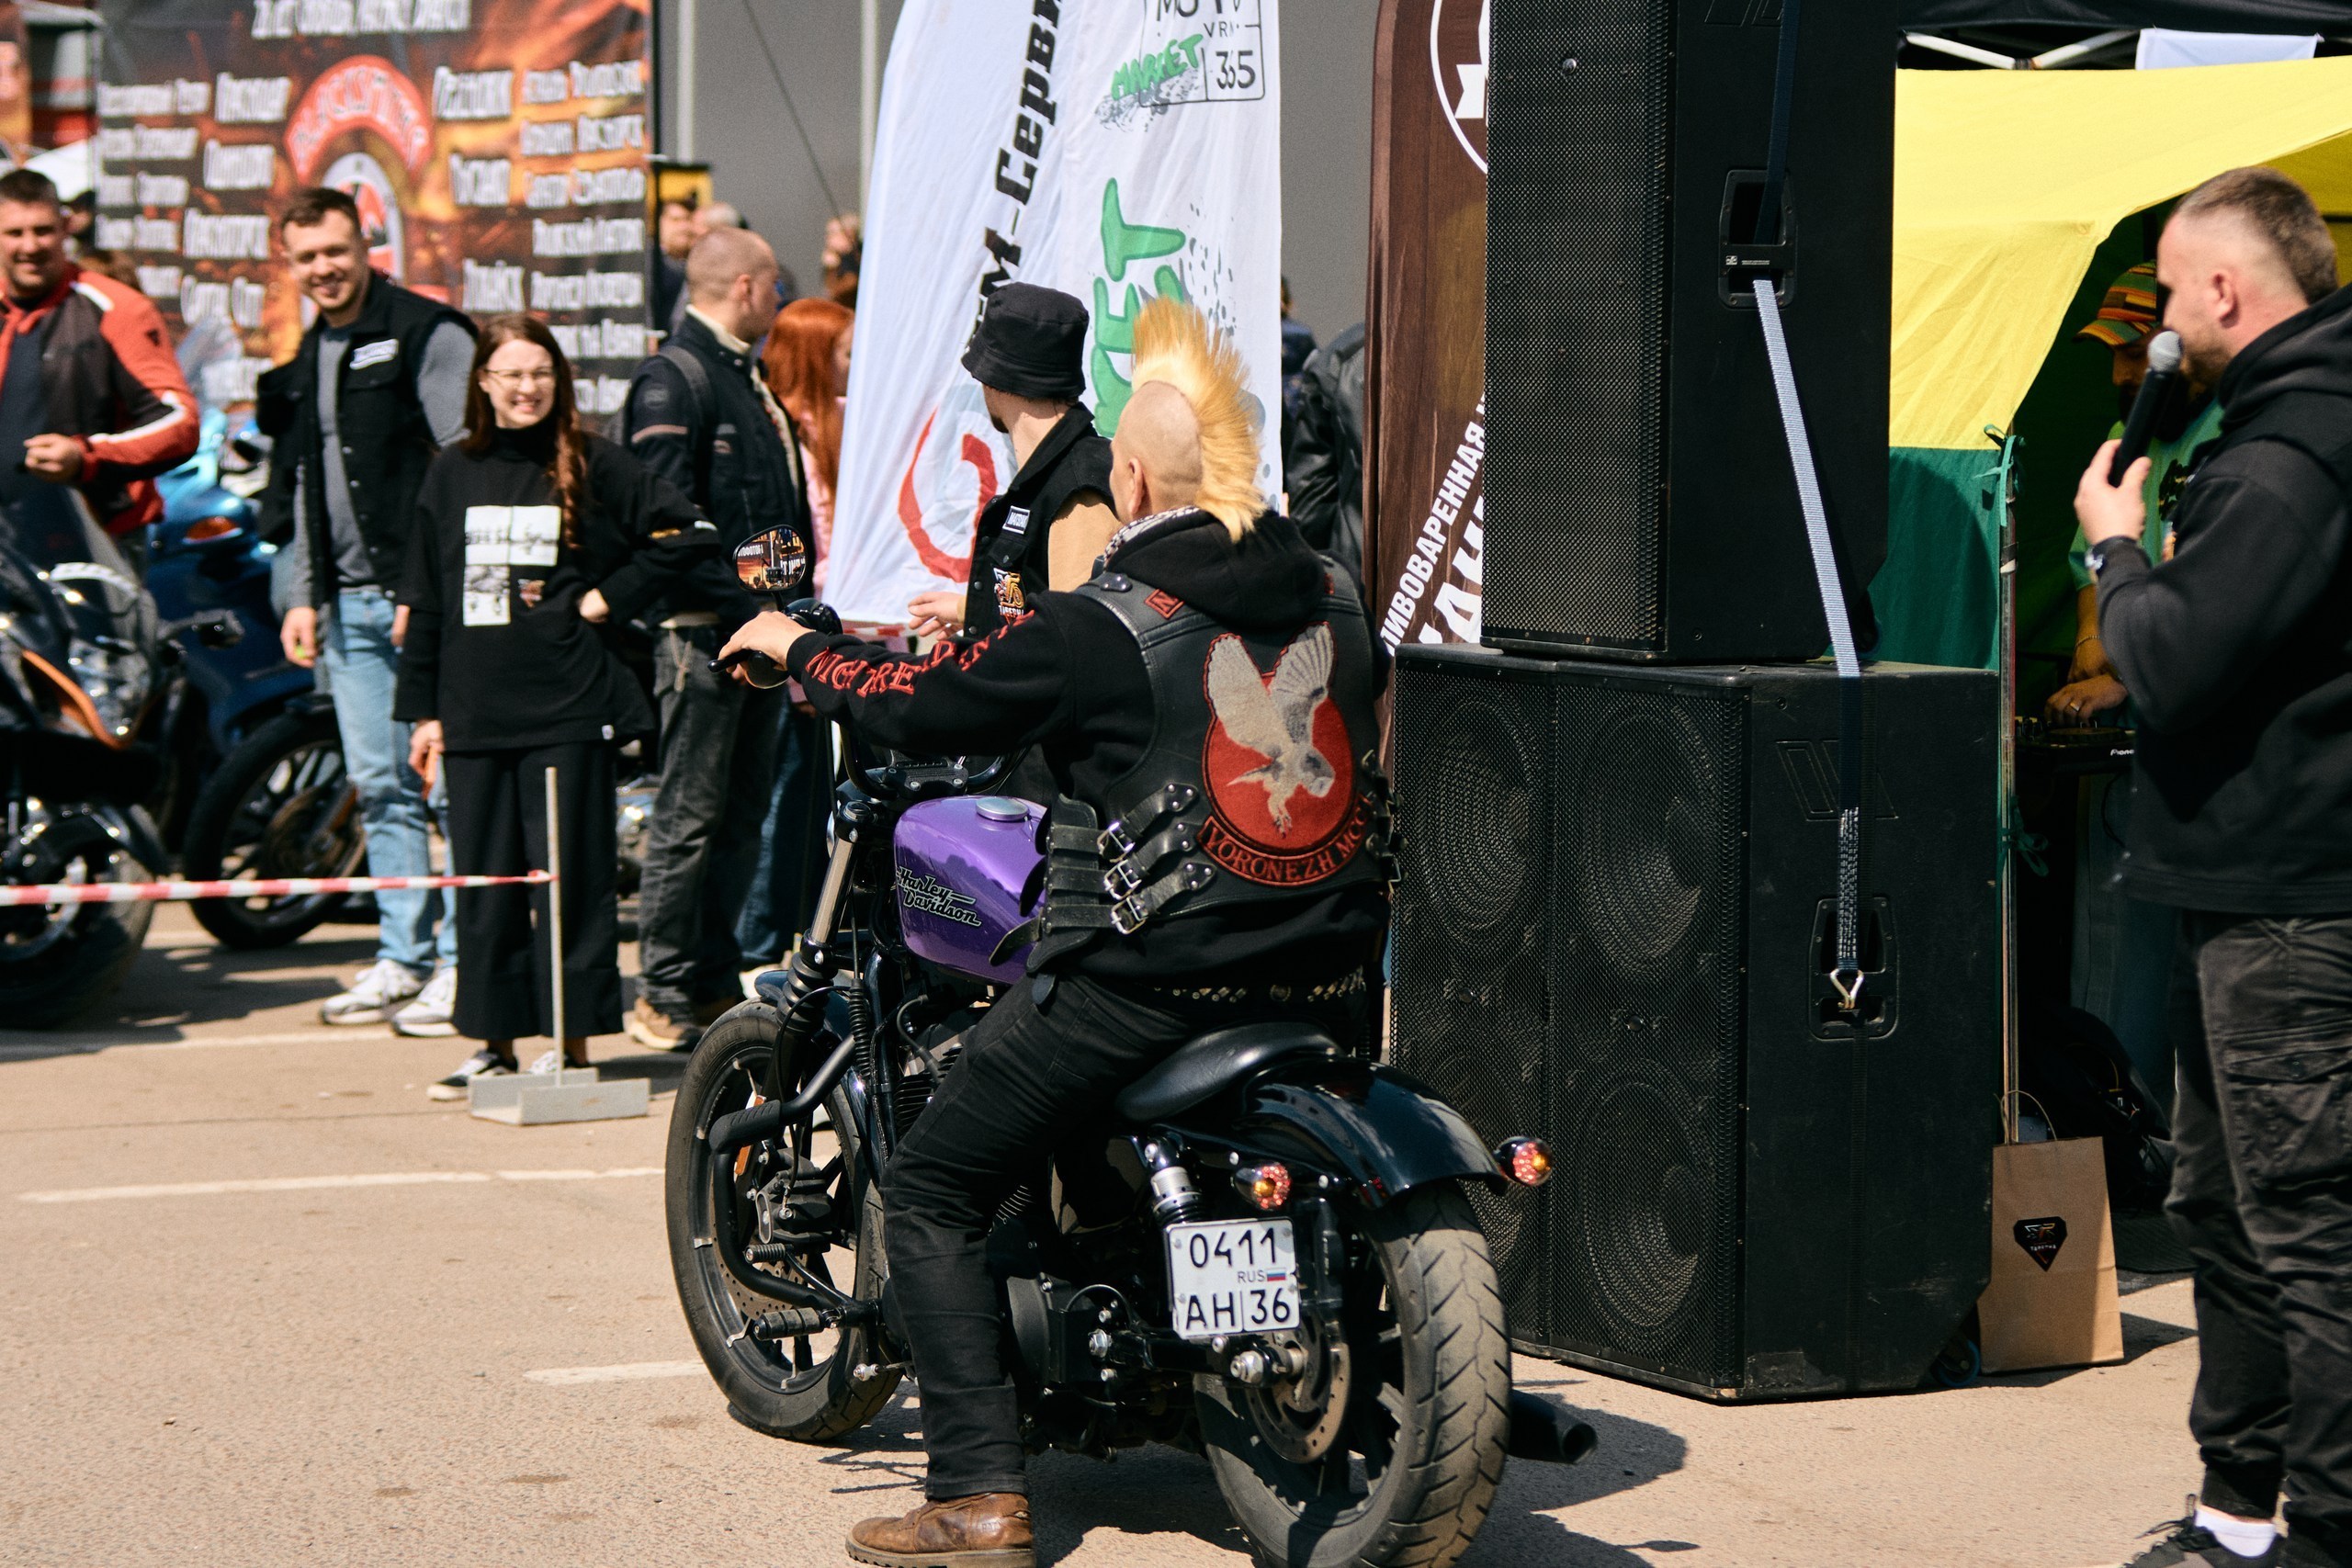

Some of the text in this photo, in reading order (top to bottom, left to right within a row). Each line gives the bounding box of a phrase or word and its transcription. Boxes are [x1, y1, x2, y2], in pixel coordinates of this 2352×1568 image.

[1206, 826, 1338, 882] VORONEZH
[903, 887, 982, 927] Davidson
[1189, 1227, 1277, 1268] 0411
[1237, 1269, 1266, 1284] RUS
[1250, 1287, 1291, 1325] 36
